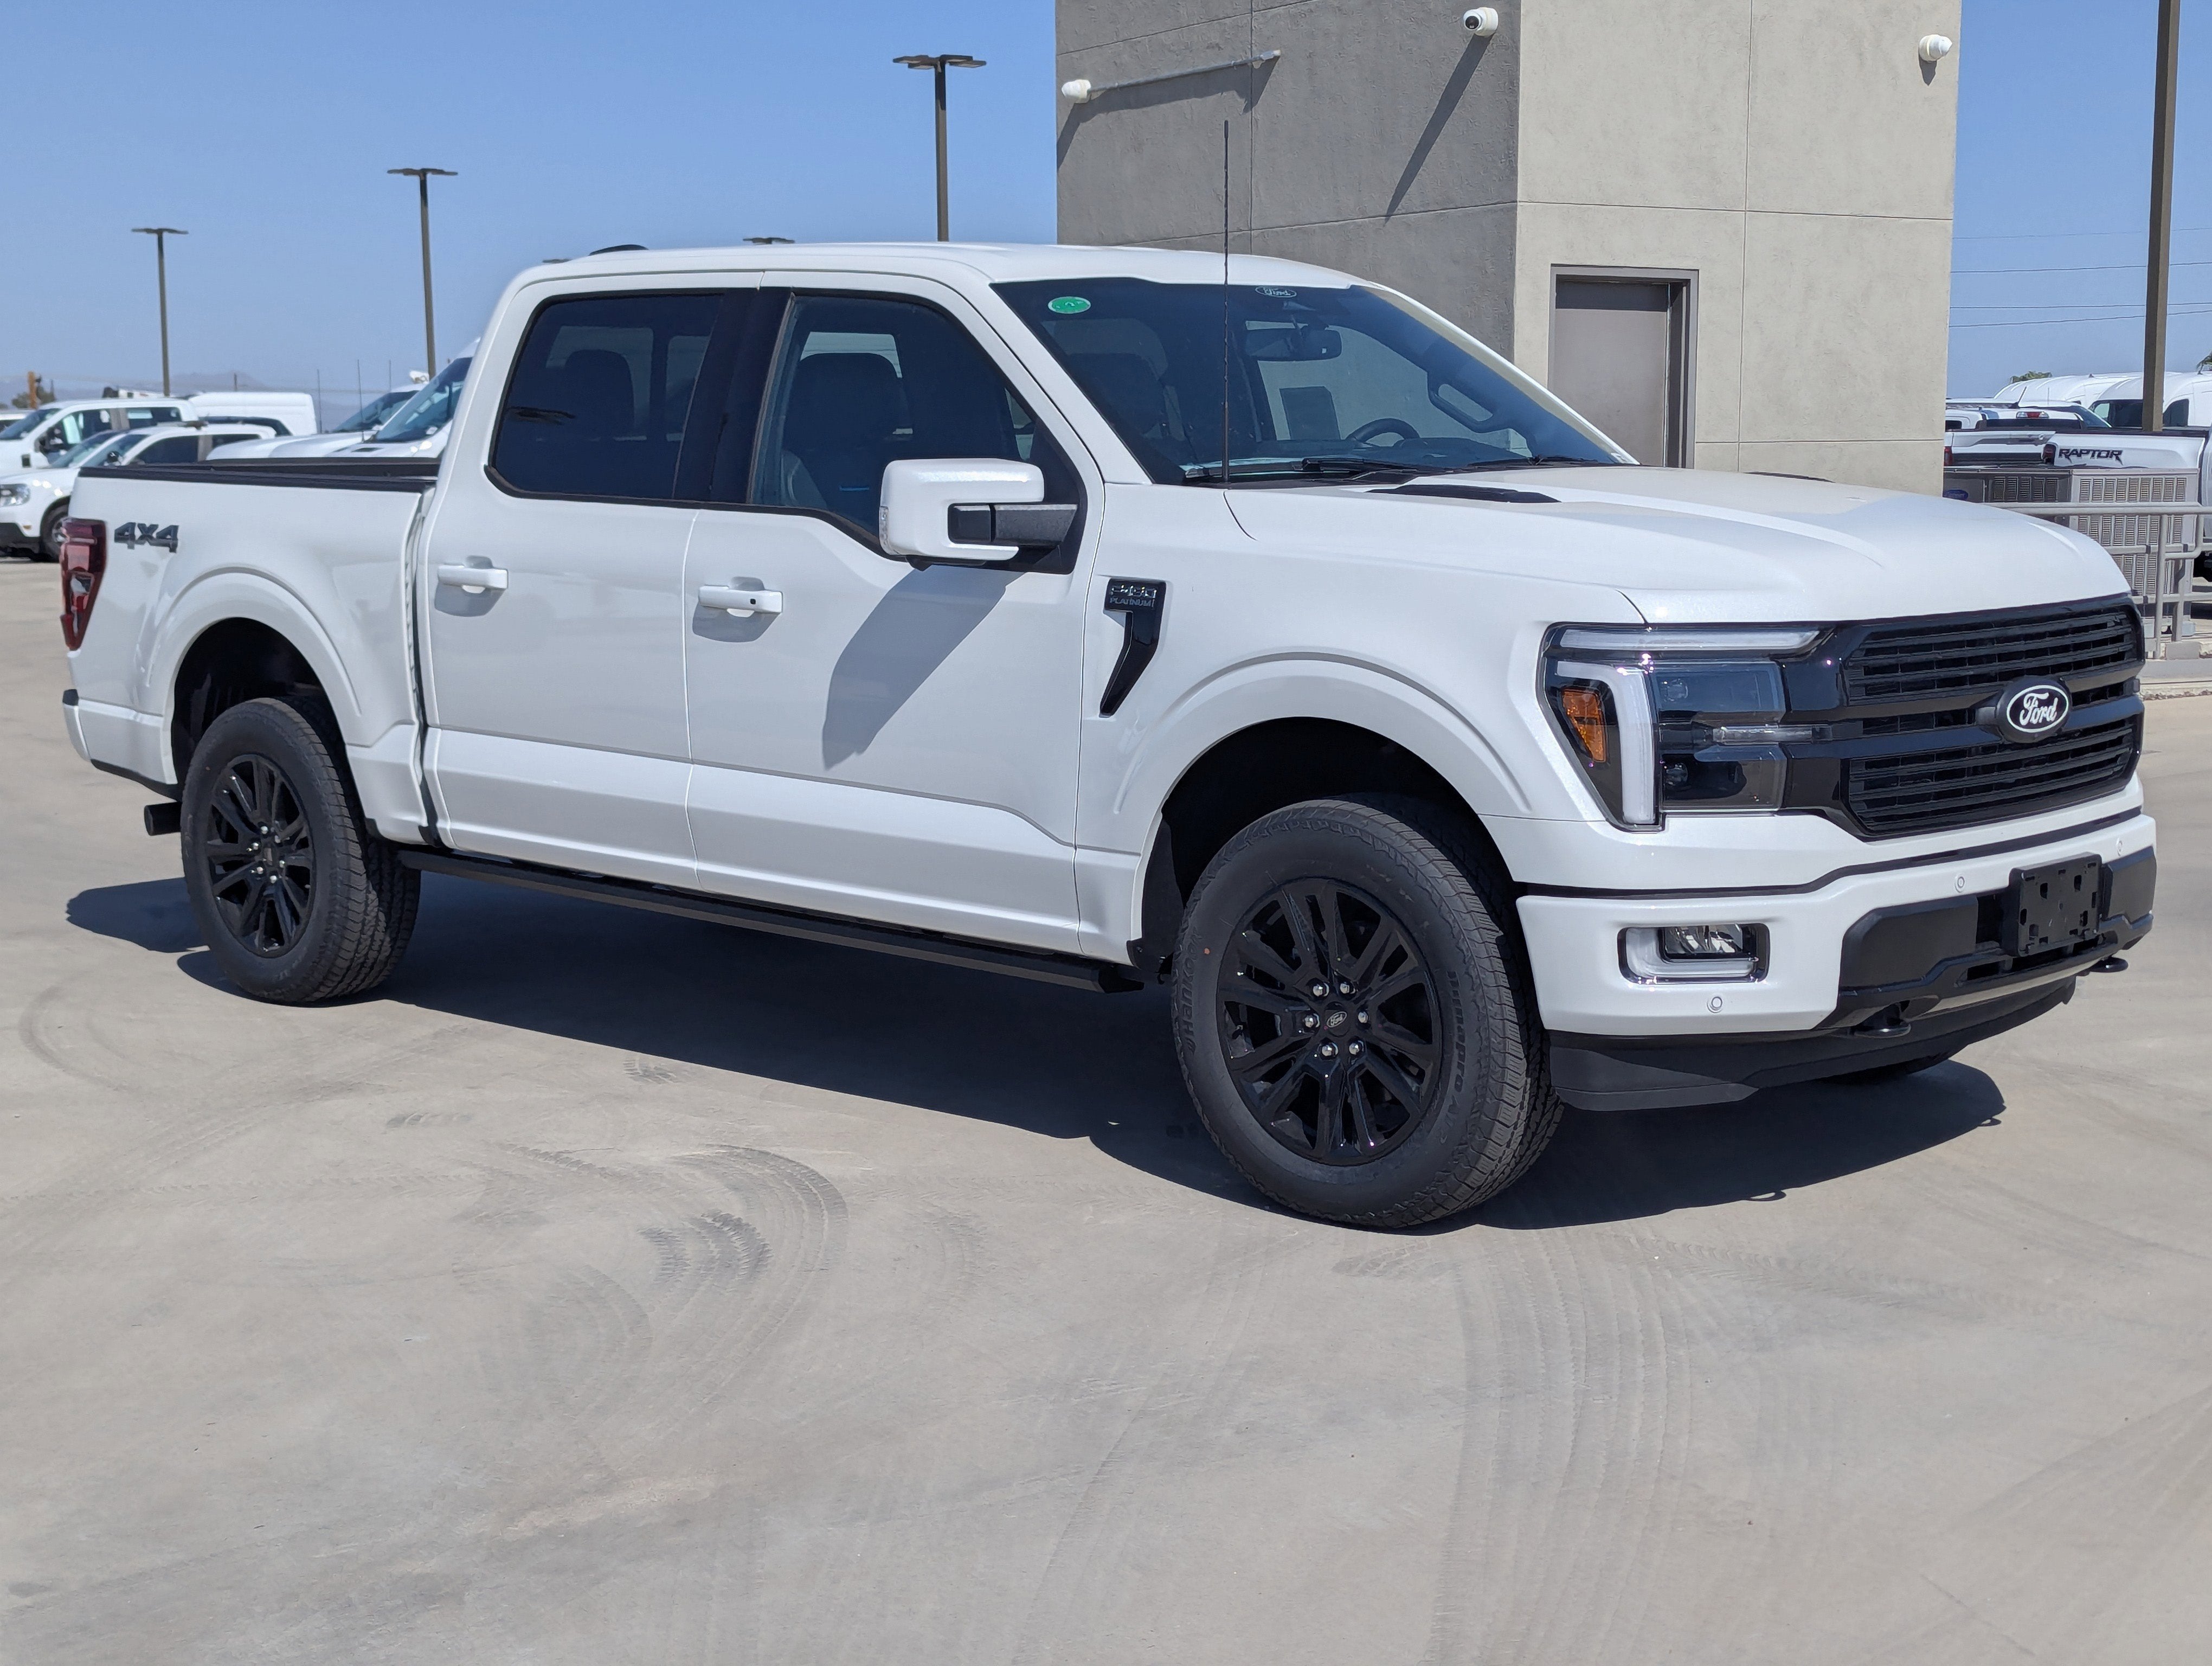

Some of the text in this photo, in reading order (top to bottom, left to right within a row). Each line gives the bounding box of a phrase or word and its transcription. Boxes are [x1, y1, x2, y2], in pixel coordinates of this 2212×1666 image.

[2059, 448, 2124, 465] RAPTOR
[1109, 597, 1155, 607] PLATINUM
[2020, 692, 2059, 726] Ford
